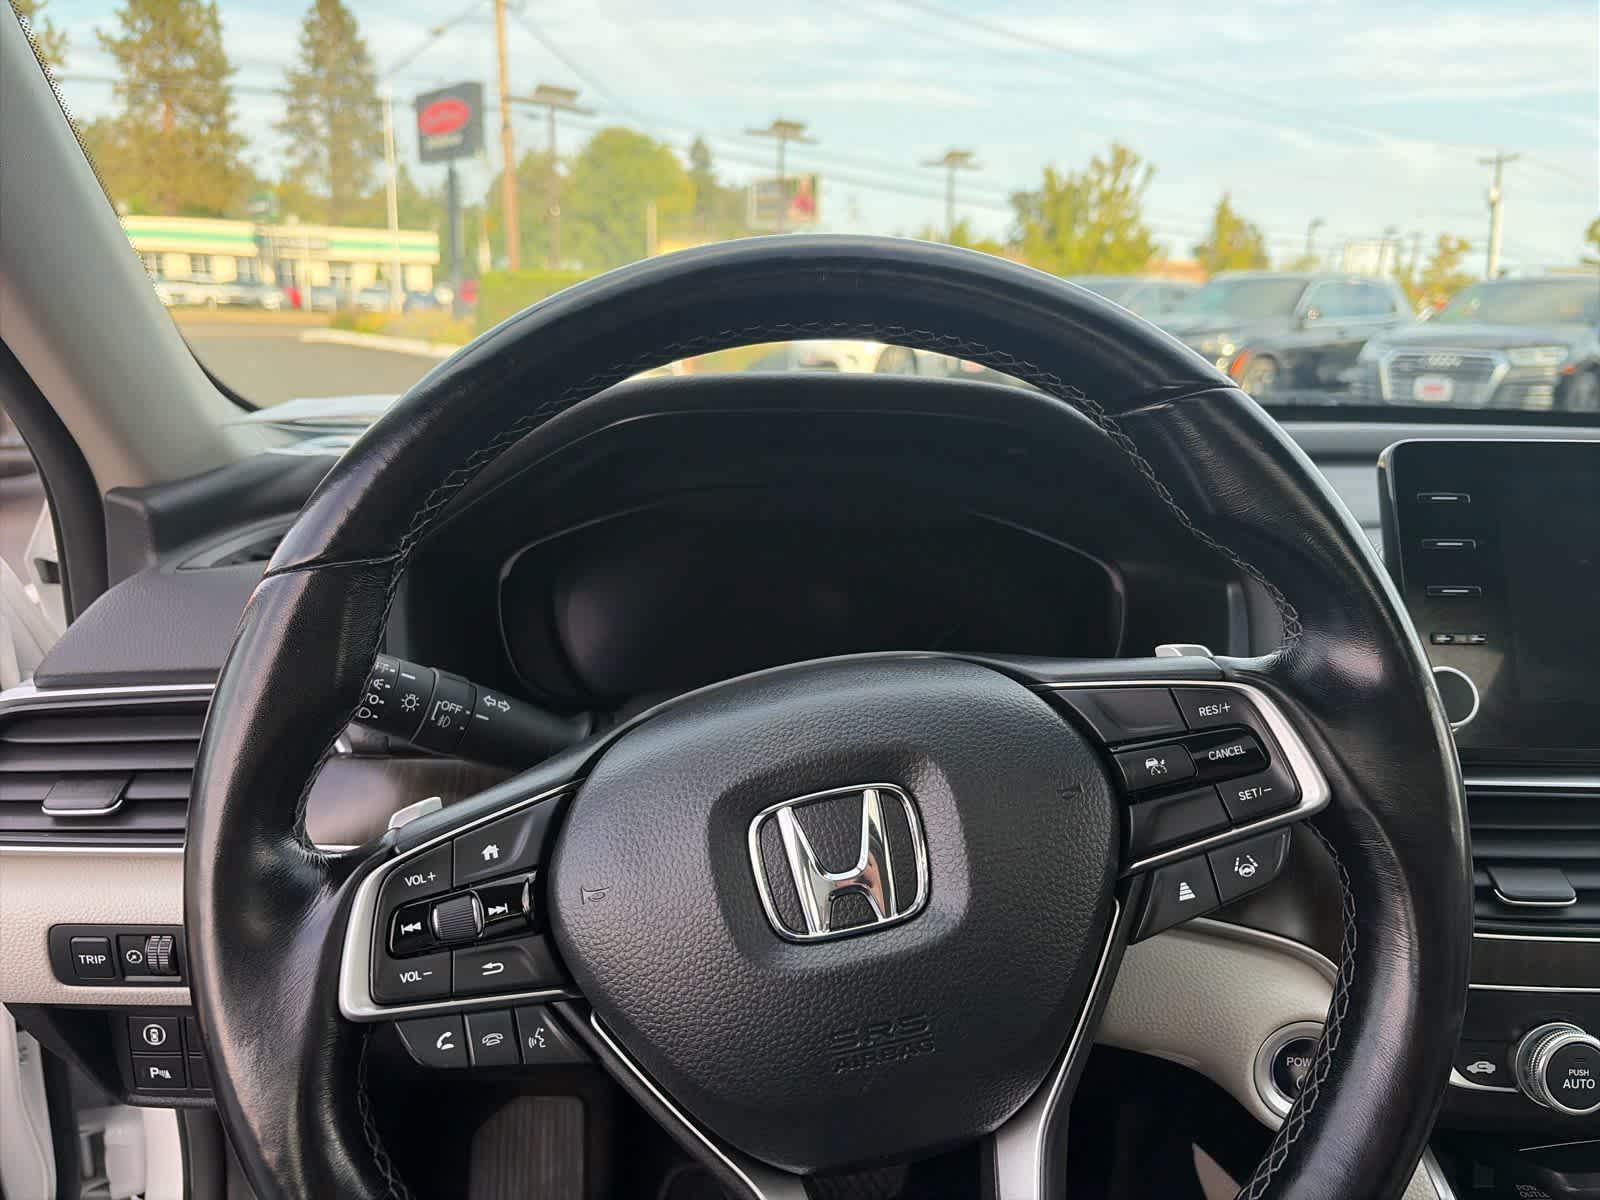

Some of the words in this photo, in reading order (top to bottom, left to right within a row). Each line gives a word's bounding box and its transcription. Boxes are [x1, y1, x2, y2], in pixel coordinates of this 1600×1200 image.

[441, 700, 464, 715] OFF
[1208, 744, 1247, 761] CANCEL
[78, 954, 106, 965] TRIP
[1286, 1056, 1312, 1067] POW
[1568, 1068, 1590, 1077] PUSH
[1562, 1078, 1596, 1090] AUTO
